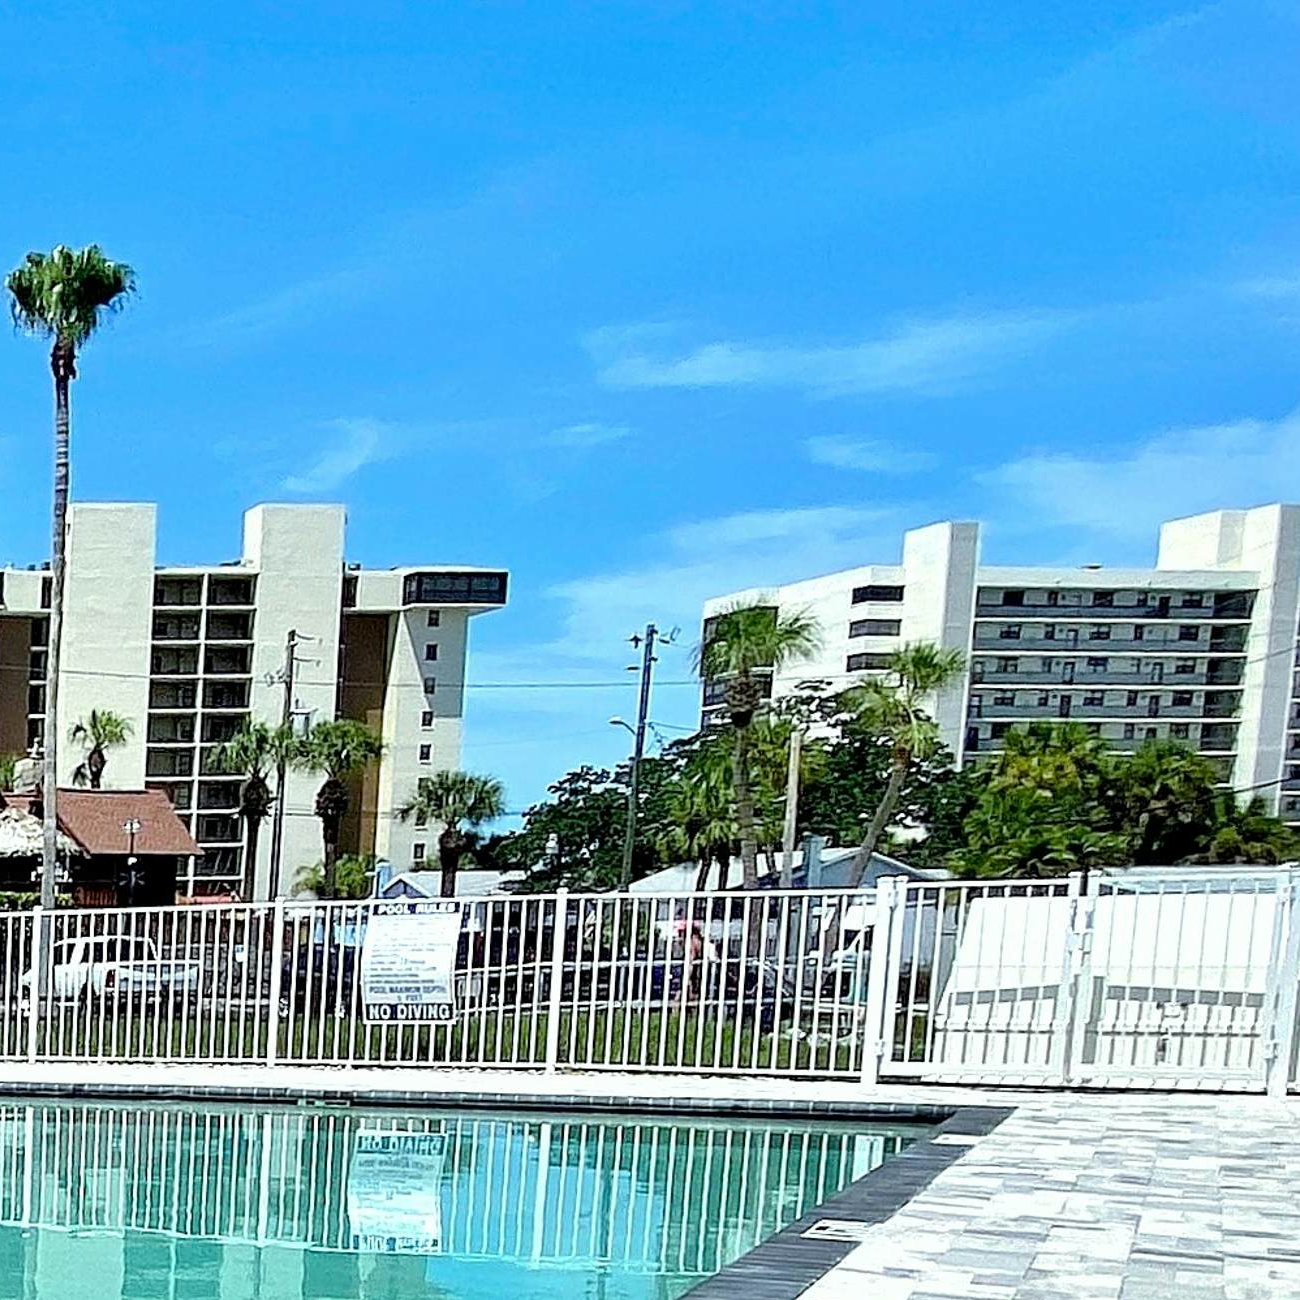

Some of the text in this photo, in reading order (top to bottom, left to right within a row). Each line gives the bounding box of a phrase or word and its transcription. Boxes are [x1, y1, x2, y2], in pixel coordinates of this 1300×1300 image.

[377, 902, 456, 914] POOL RULES
[369, 1004, 450, 1020] NO DIVING
